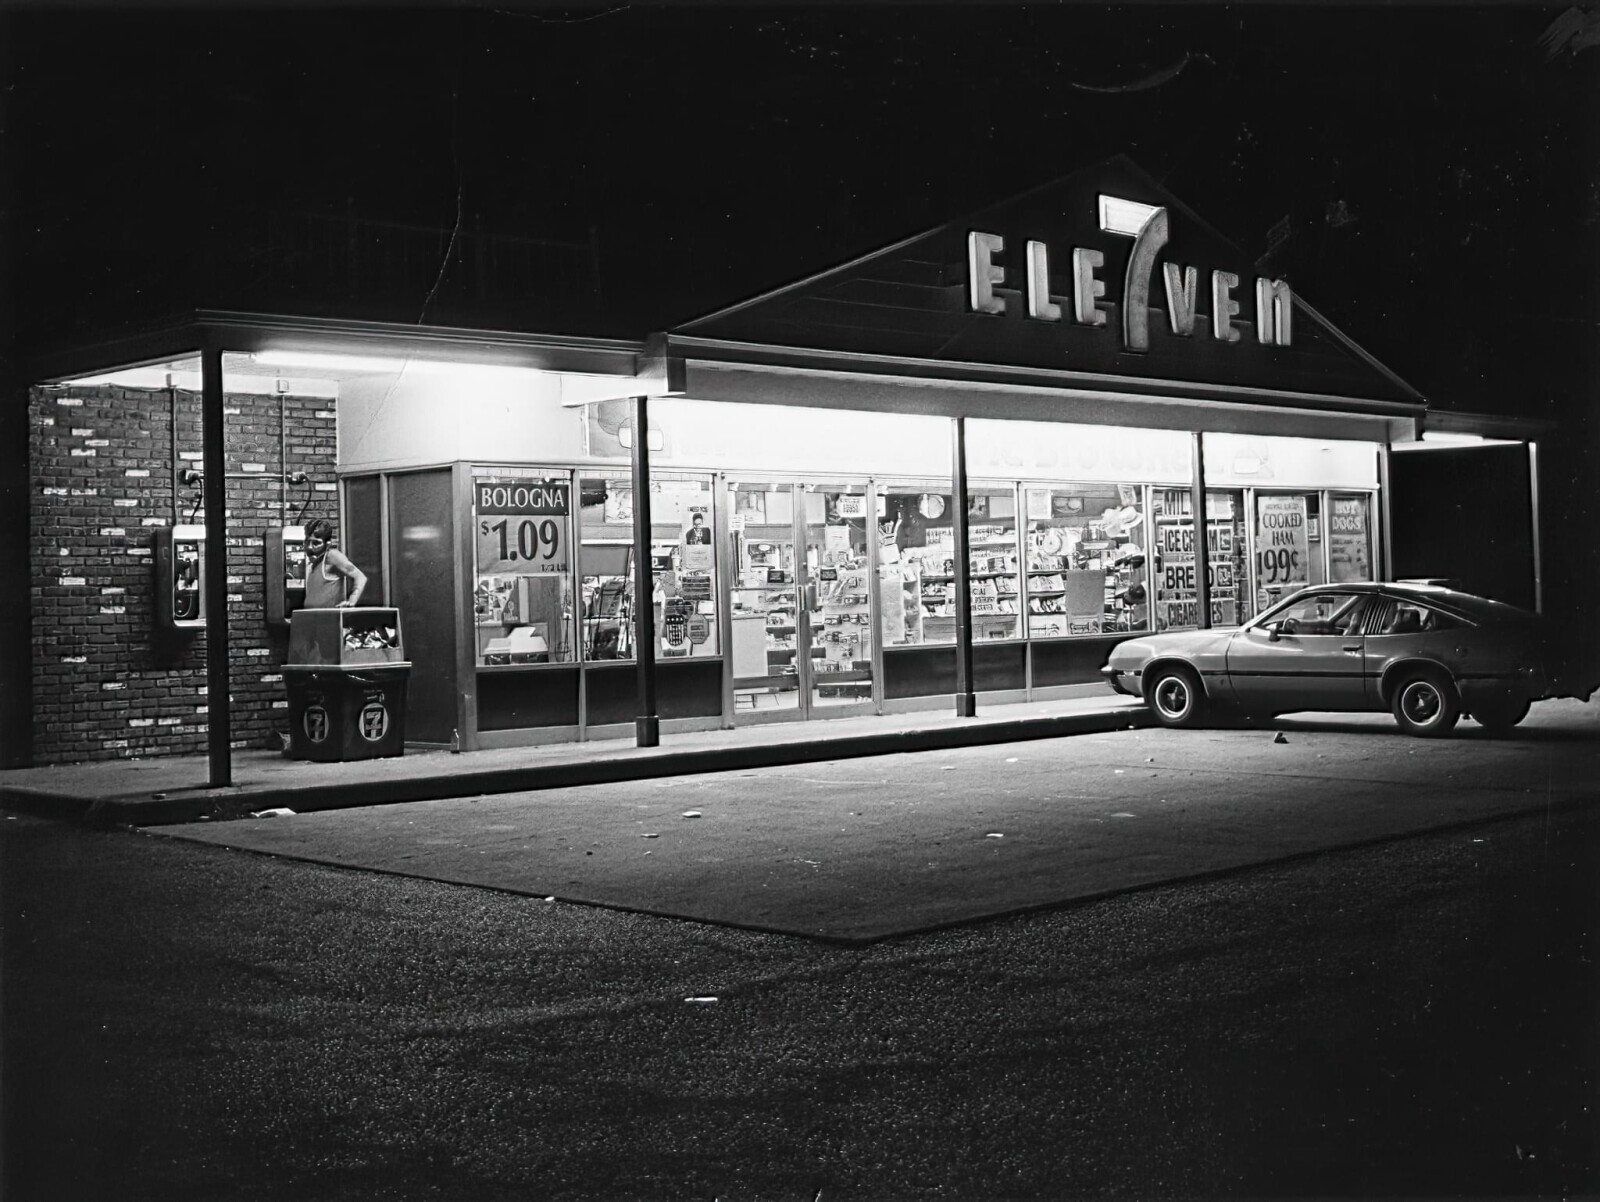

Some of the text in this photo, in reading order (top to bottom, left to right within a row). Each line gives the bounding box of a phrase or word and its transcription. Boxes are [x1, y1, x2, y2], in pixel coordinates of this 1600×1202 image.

[1098, 194, 1168, 353] 7
[481, 487, 565, 508] BOLOGNA
[1262, 512, 1303, 529] COOKED
[1332, 516, 1361, 531] DOGS
[481, 519, 559, 561] $1.09
[1164, 529, 1218, 552] ICE CRM
[1272, 531, 1295, 546] HAM
[1166, 566, 1215, 589] BRED
[1168, 600, 1223, 626] CIGAREES
[366, 711, 382, 738] 7
